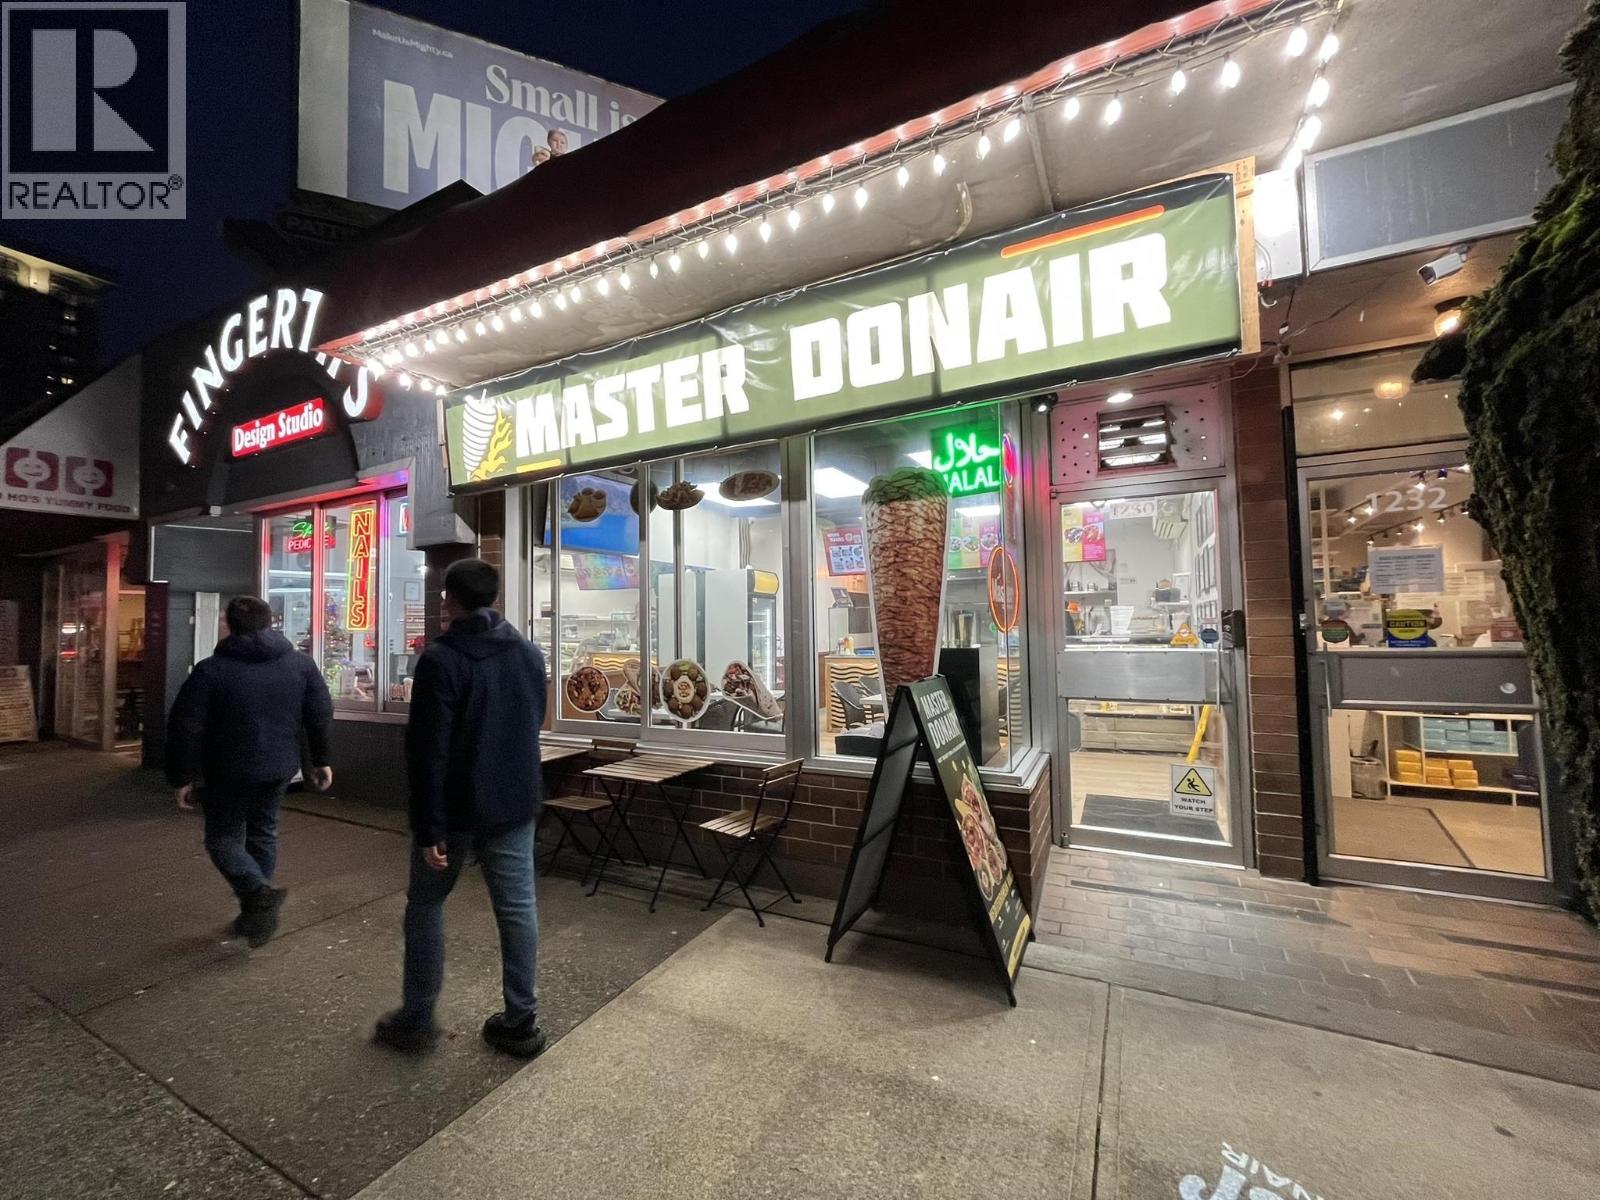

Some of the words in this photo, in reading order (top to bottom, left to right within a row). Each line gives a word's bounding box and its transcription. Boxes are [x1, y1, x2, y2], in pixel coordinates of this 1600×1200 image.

[485, 64, 599, 132] Small
[515, 346, 750, 458] MASTER
[788, 232, 1172, 404] DONAIR
[234, 419, 275, 452] Design
[278, 402, 323, 438] Studio
[1366, 487, 1450, 513] 1232
[350, 511, 372, 628] NAILS
[920, 689, 950, 720] MASTER
[927, 711, 961, 750] DONAIR
[1174, 804, 1194, 812] YOUR
[1181, 797, 1206, 805] WATCH
